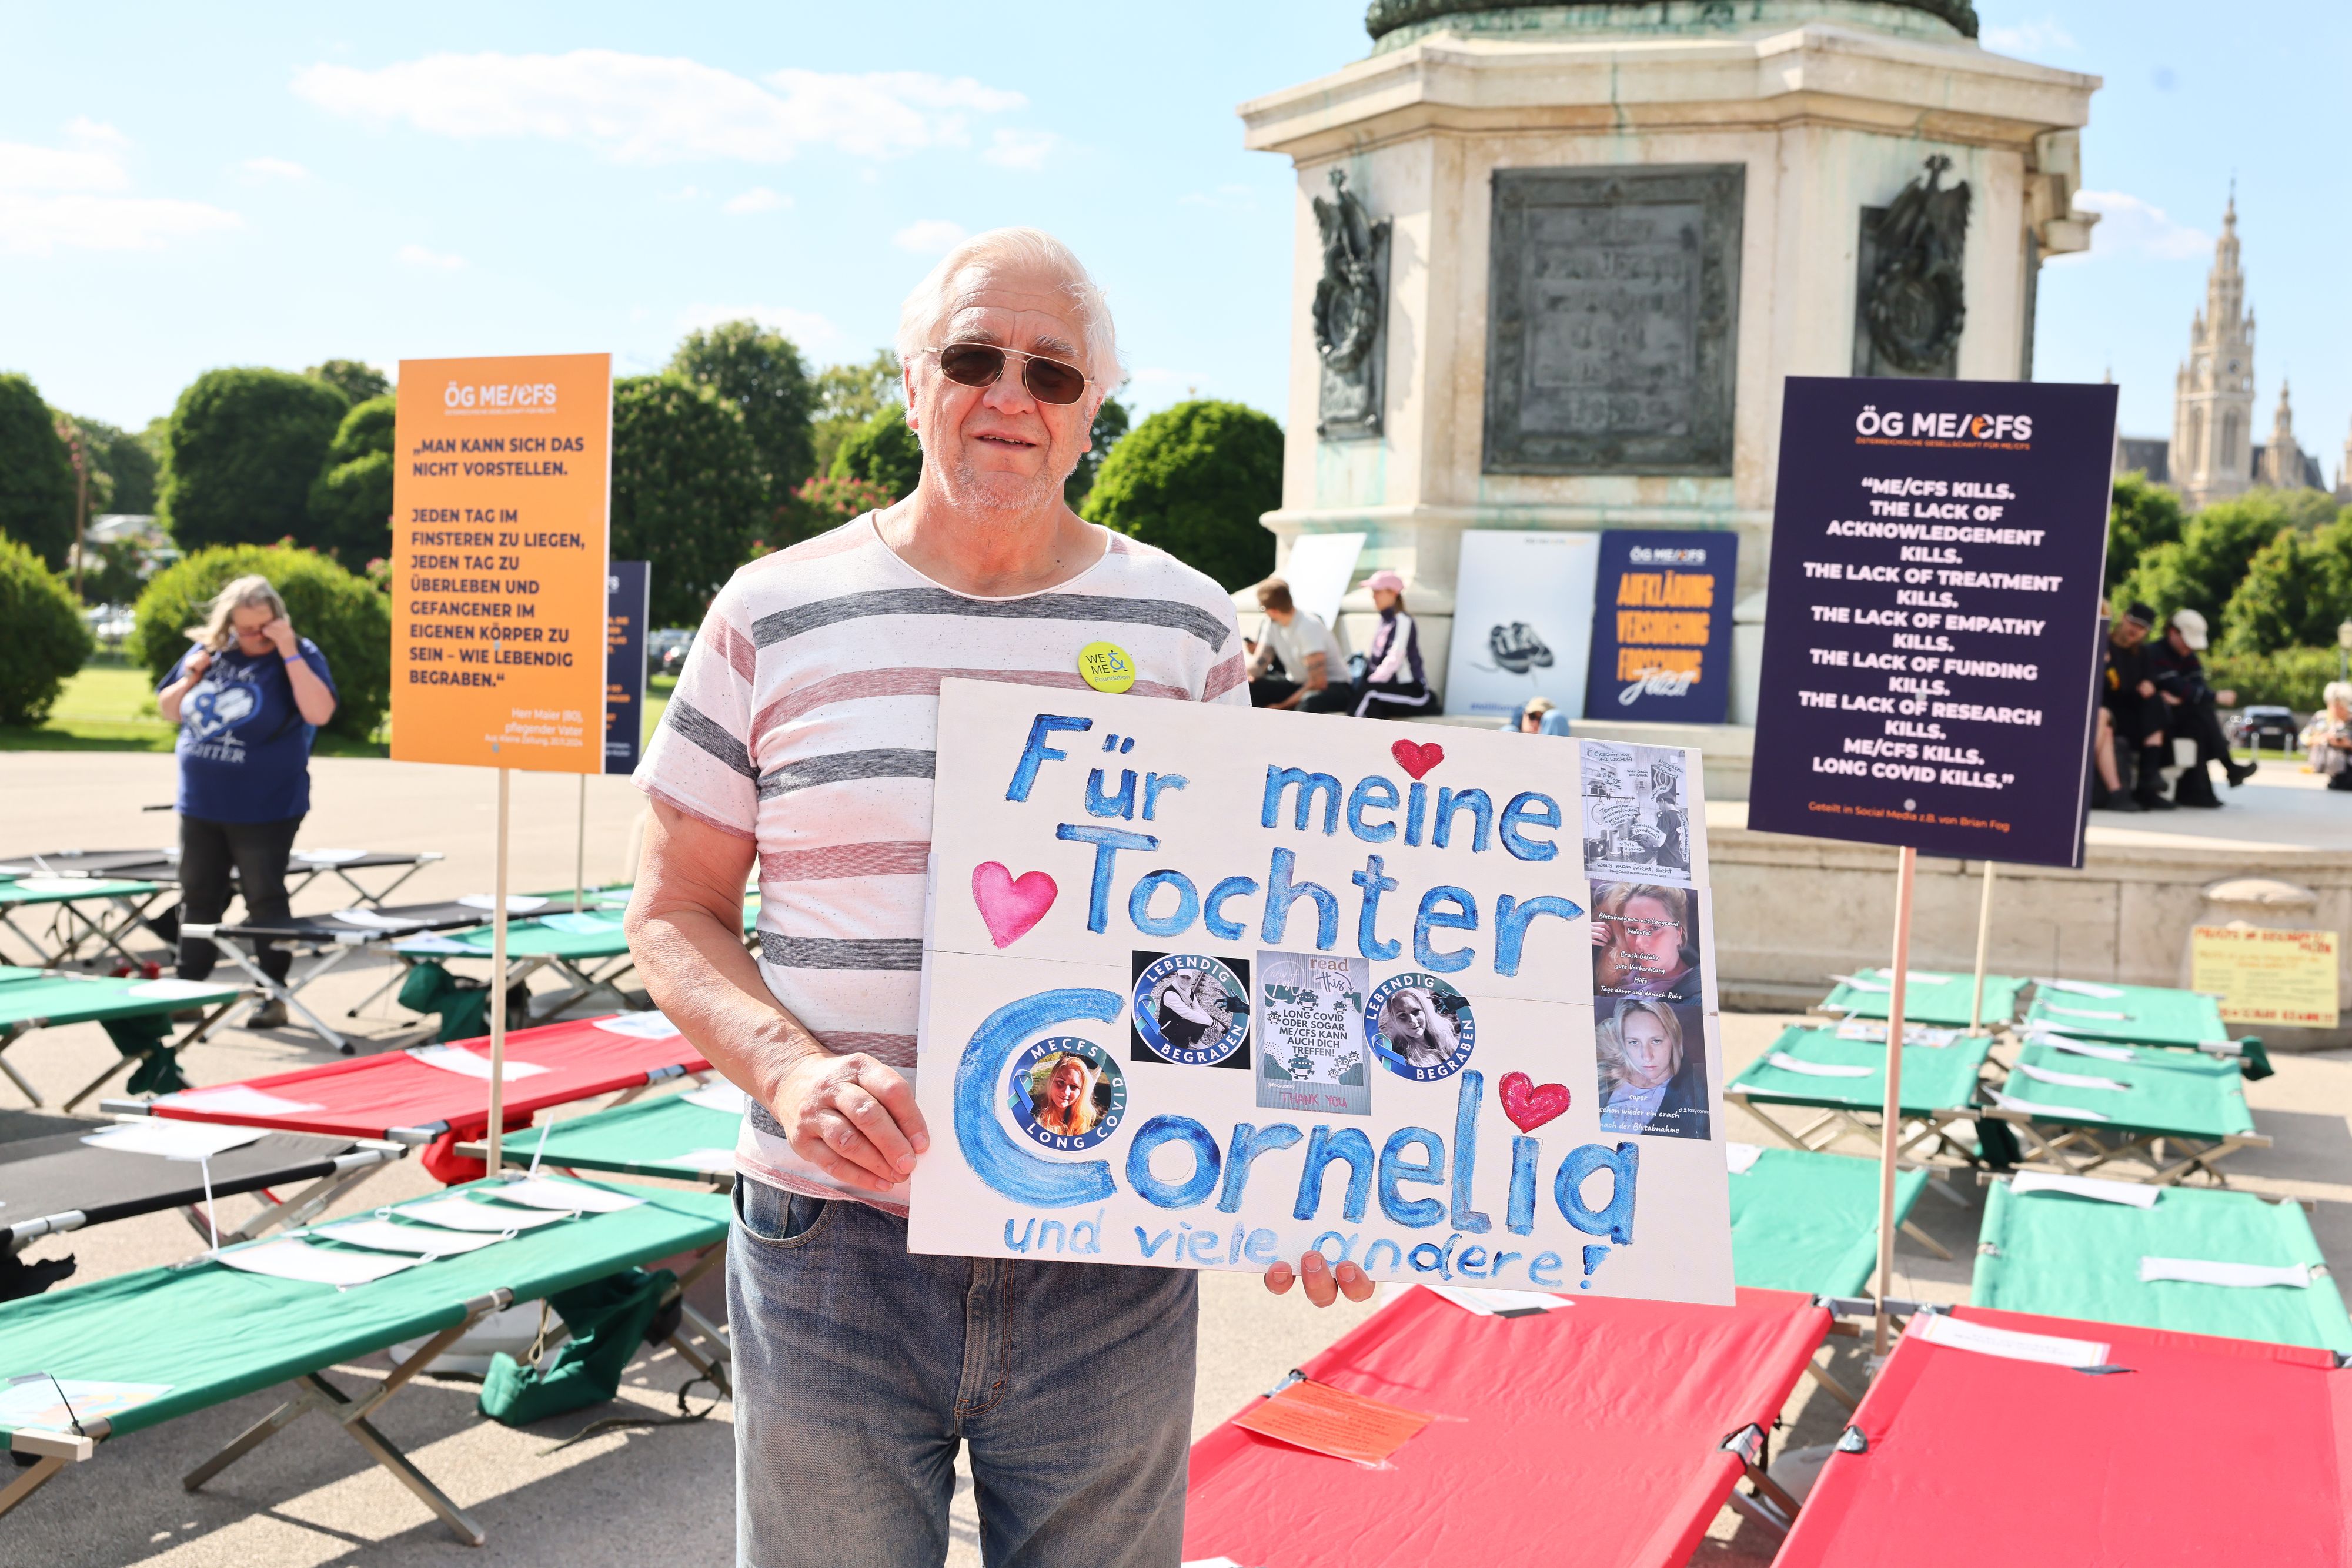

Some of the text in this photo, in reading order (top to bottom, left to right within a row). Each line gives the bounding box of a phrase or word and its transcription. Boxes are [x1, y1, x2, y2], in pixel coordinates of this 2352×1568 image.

[444, 380, 556, 407] ÖG ME/CFS
[1856, 405, 2033, 441] ÖG ME/CFS
[462, 438, 505, 452] KANN
[510, 438, 545, 452] SICH
[552, 437, 583, 452] DAS
[413, 462, 567, 476] NICHT VORSTELLEN.
[1862, 477, 2015, 500] “ME/CFS KILLS.
[412, 509, 517, 523] JEDEN TAG IM
[1870, 500, 2003, 522] THE LACK OF
[412, 532, 585, 550] FINSTEREN ZU LIEGEN,
[1826, 520, 2044, 546] ACKNOWLEDGEMENT
[411, 556, 519, 570] JEDEN TAG ZU
[1900, 546, 1962, 564] KILLS.
[411, 574, 539, 594] ÜBERLEBEN UND
[1803, 562, 2062, 593] THE LACK OF TREATMENT
[410, 601, 534, 618] GEFANGENER IM
[1897, 590, 1958, 609] KILLS.
[1811, 606, 2045, 636] THE LACK OF EMPATHY
[410, 623, 569, 643] EIGENEN KÖRPER ZU
[1893, 633, 1955, 652] KILLS.
[410, 647, 573, 667] SEIN WIE LEBENDIG
[1085, 654, 1106, 664] WE
[1810, 649, 2038, 681] THE LACK OF FUNDING
[409, 670, 504, 687] BEGRABEN.“
[1091, 664, 1110, 674] ME
[1889, 676, 1950, 696] KILLS.
[1799, 691, 2042, 726] THE LACK OF RESEARCH
[1885, 720, 1946, 739] KILLS.
[1843, 738, 1984, 765] ME/CFS KILLS.
[1813, 757, 2014, 789] LONG COVID KILLS.”
[1005, 713, 1190, 821] Für
[1261, 764, 1562, 861] meine
[1808, 801, 1841, 813] Geteilt
[1843, 804, 1853, 814] in
[1855, 805, 1885, 817] Social
[1886, 809, 1917, 821] Media
[1939, 816, 1957, 824] von
[1960, 816, 1988, 828] Brian
[1990, 820, 2010, 833] Fog
[1055, 822, 1585, 977] Tochter
[1598, 912, 1639, 922] Blutabnehmen
[1652, 918, 1679, 927] Longcovid
[1627, 928, 1651, 936] bedeutet
[1147, 957, 1230, 982] LEBENDIG
[1309, 959, 1348, 971] read
[1629, 964, 1665, 974] Vorbereitung
[1316, 972, 1344, 992] this
[1367, 975, 1434, 1020] LEBENDIG
[1282, 1018, 1344, 1031] ODER SOGAR
[1283, 1009, 1344, 1022] LONG COVID
[1161, 1024, 1243, 1062] BEGRABEN
[1279, 1027, 1347, 1039] ME/CFS KANN
[1287, 1037, 1339, 1048] AUCH DICH
[1031, 1039, 1098, 1059] MECFS
[1293, 1046, 1334, 1057] TREFFEN!
[1416, 1020, 1473, 1079] BEGRABEN
[1279, 1092, 1347, 1108] THANK YOU
[953, 988, 1639, 1245] Cornelia
[1027, 1077, 1124, 1148] LONG COVID
[1599, 1106, 1620, 1115] schon
[1632, 1122, 1679, 1134] Blutabnahme
[1004, 1208, 1105, 1254] und
[1135, 1219, 1278, 1266] viele
